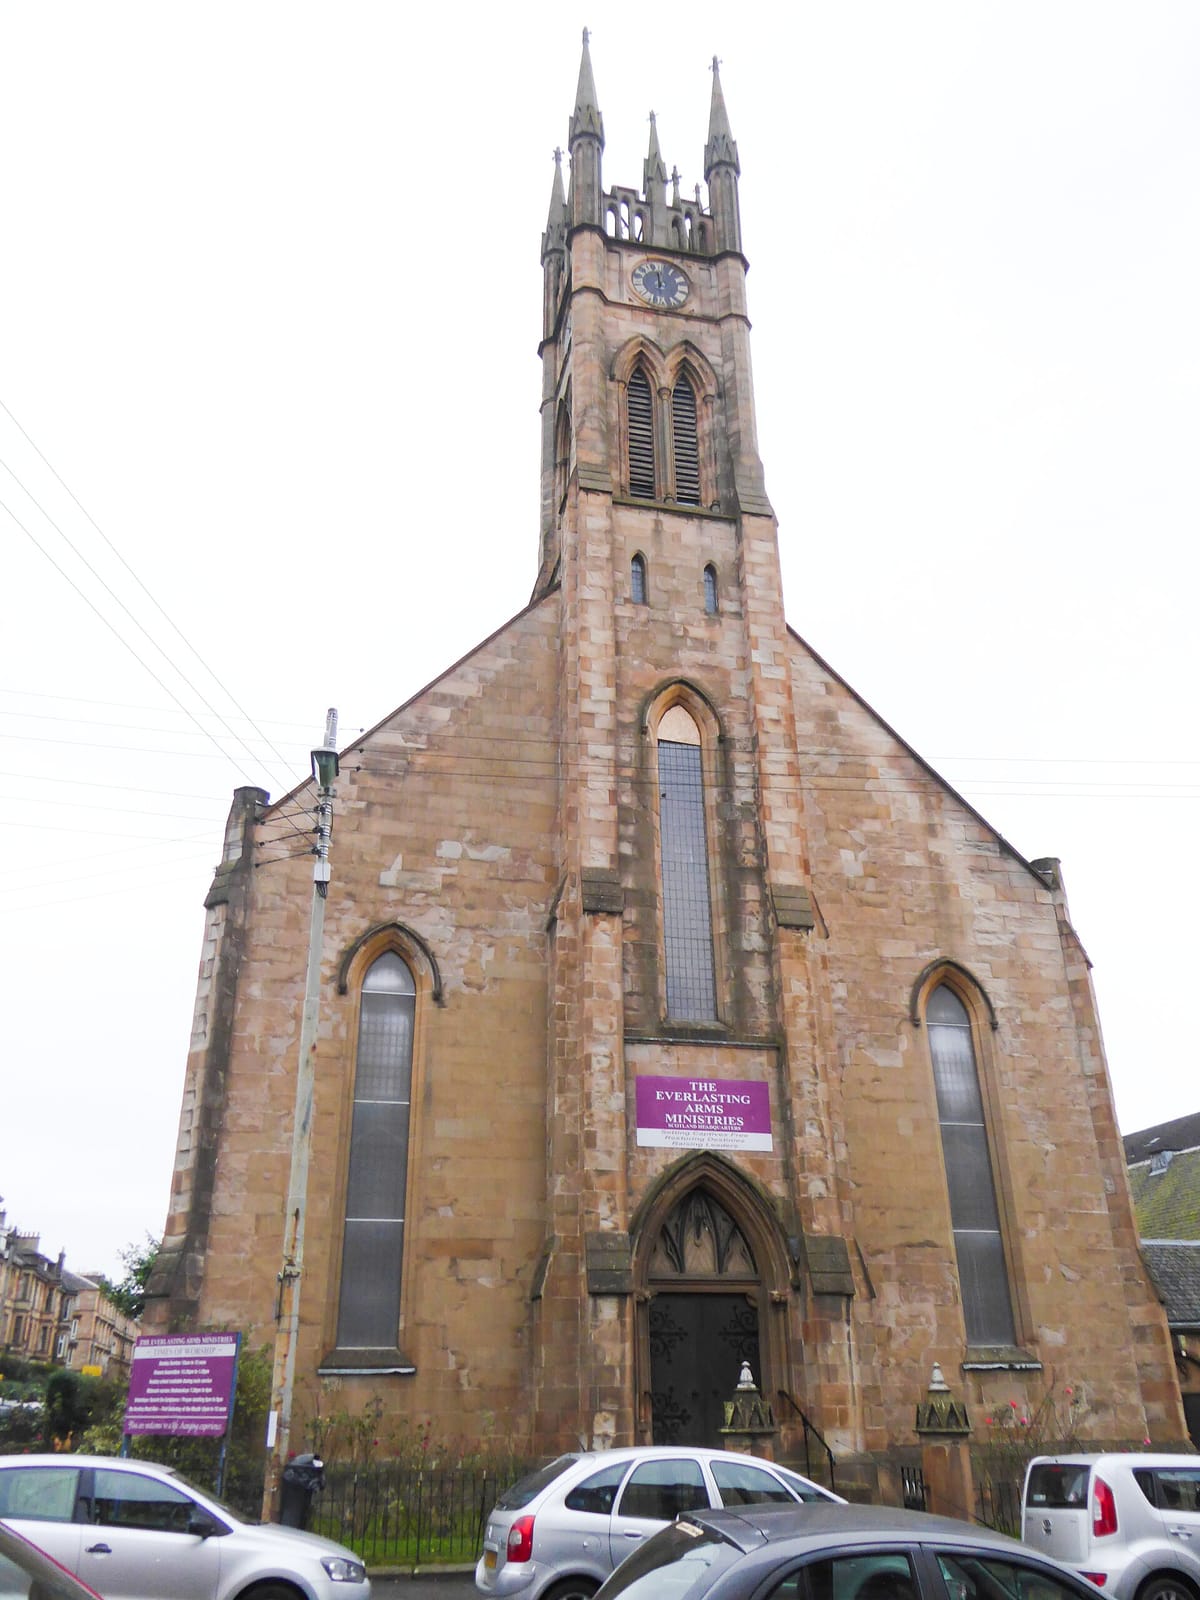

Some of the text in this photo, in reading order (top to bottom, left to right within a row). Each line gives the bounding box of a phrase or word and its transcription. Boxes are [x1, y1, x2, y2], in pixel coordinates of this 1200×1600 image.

[689, 1081, 717, 1092] THE
[656, 1091, 751, 1105] EVERLASTING
[685, 1104, 724, 1115] ARMS
[665, 1113, 744, 1126] MINISTRIES
[151, 1337, 186, 1346] EVERLASTING
[202, 1335, 233, 1344] MINISTRIES
